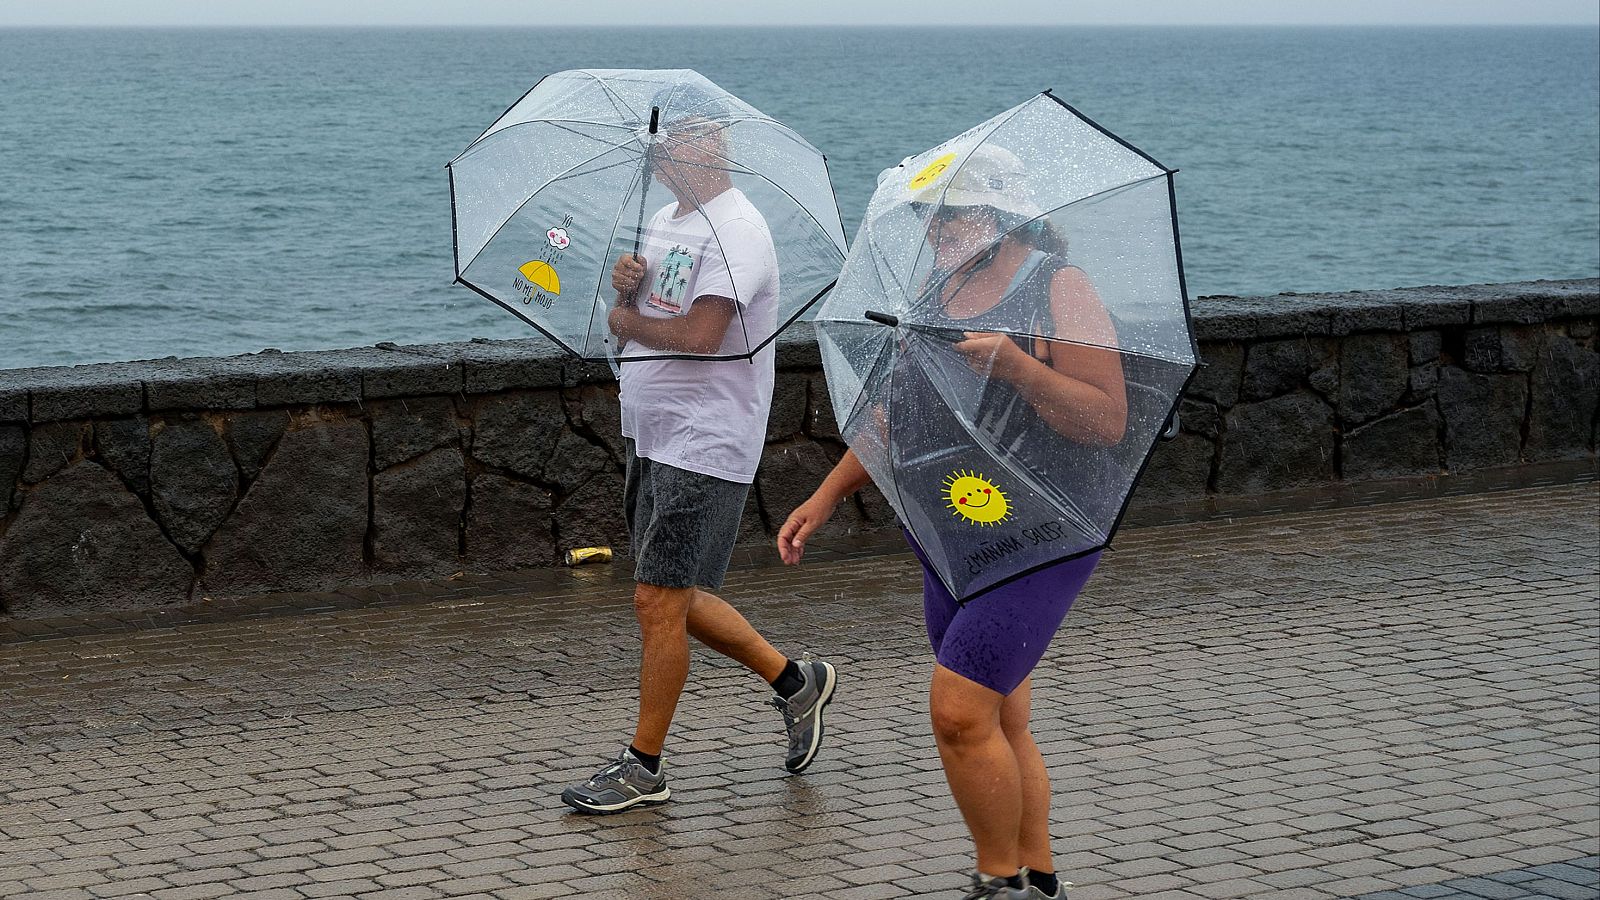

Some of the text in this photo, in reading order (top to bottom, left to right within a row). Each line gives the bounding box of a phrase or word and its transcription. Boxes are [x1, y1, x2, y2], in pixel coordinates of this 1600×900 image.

[562, 214, 573, 228] YO
[512, 277, 552, 310] NO ME MOJO
[963, 521, 1067, 575] ¿MAÑANA SALES?
